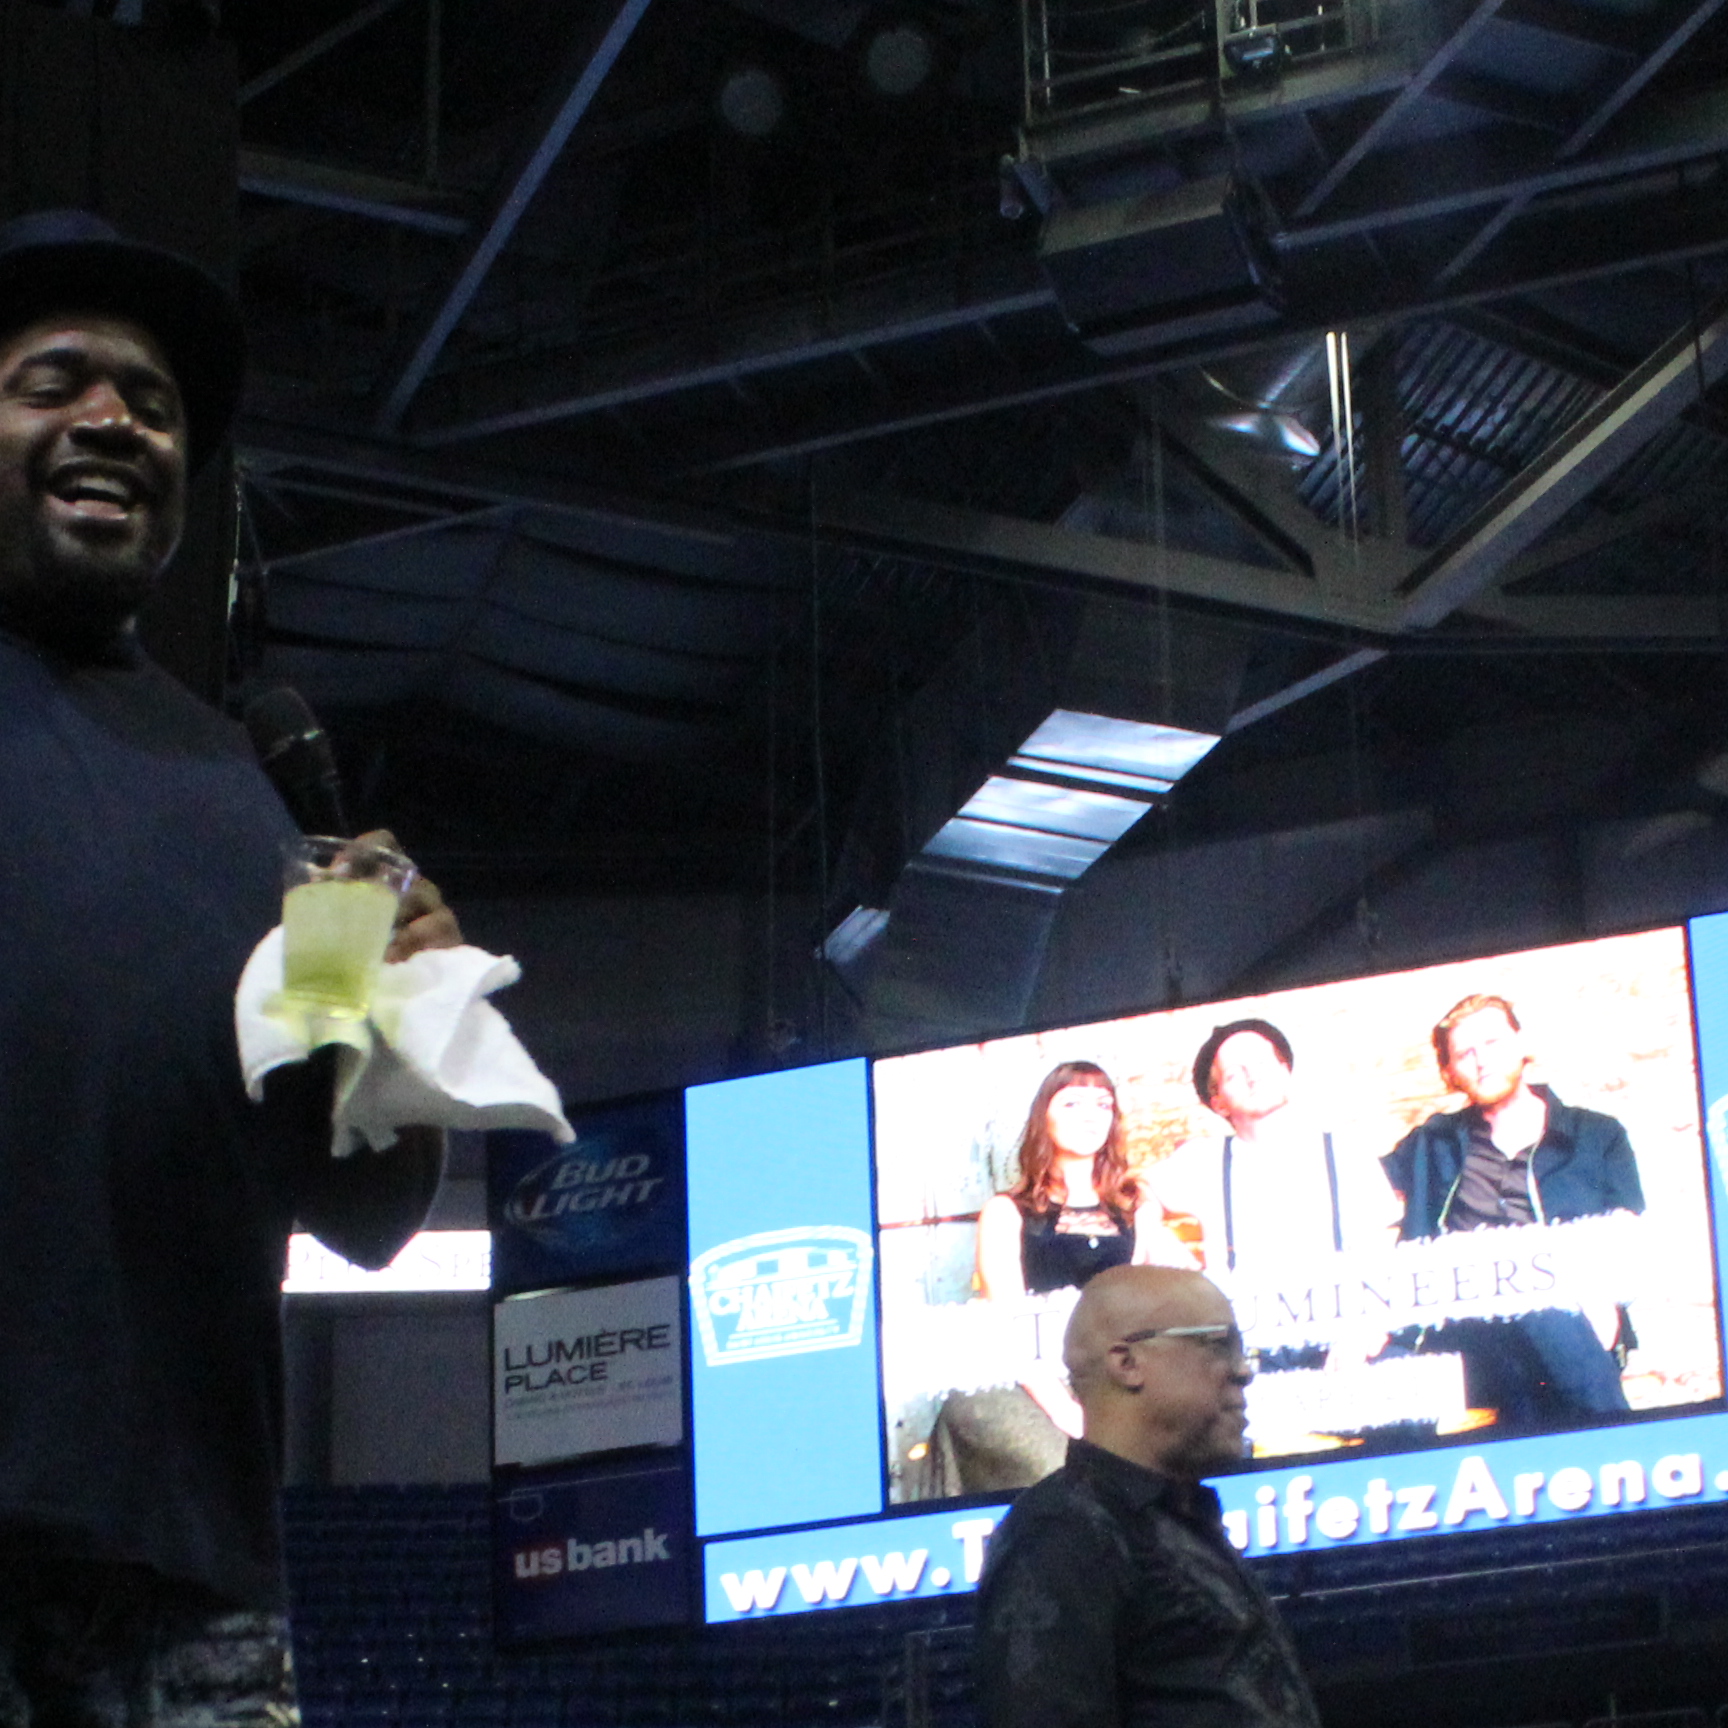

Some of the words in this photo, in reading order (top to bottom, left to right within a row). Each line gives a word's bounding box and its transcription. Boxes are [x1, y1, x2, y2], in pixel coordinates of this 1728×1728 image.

[551, 1154, 650, 1191] BUD
[528, 1177, 664, 1222] LIGHT
[503, 1324, 672, 1371] LUMIÈRE
[504, 1361, 609, 1394] PLACE
